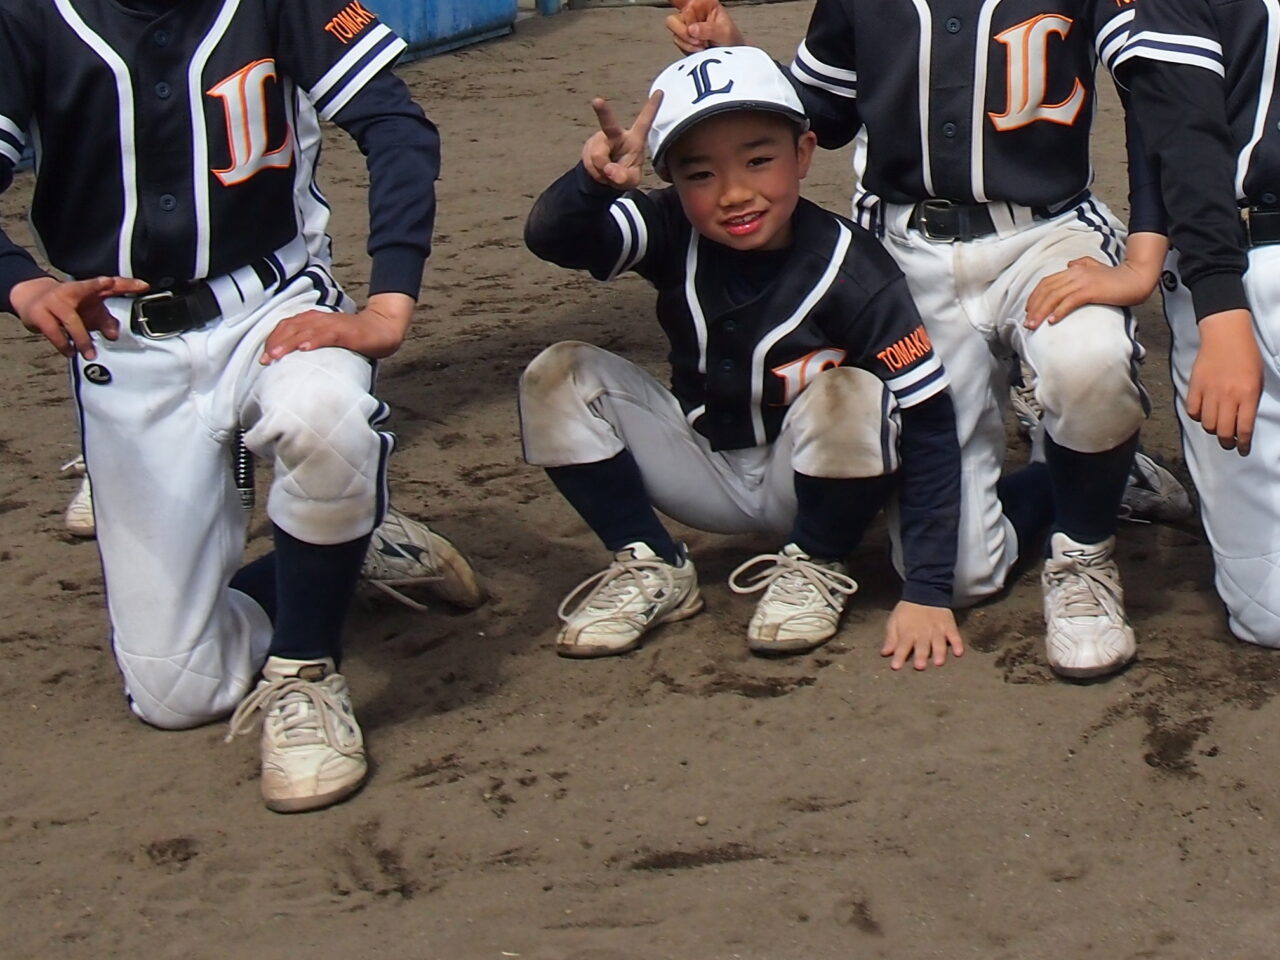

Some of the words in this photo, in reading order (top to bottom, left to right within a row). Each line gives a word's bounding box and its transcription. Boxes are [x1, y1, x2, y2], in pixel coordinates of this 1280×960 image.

[206, 58, 294, 187] L
[686, 58, 735, 105] L
[988, 13, 1086, 131] L
